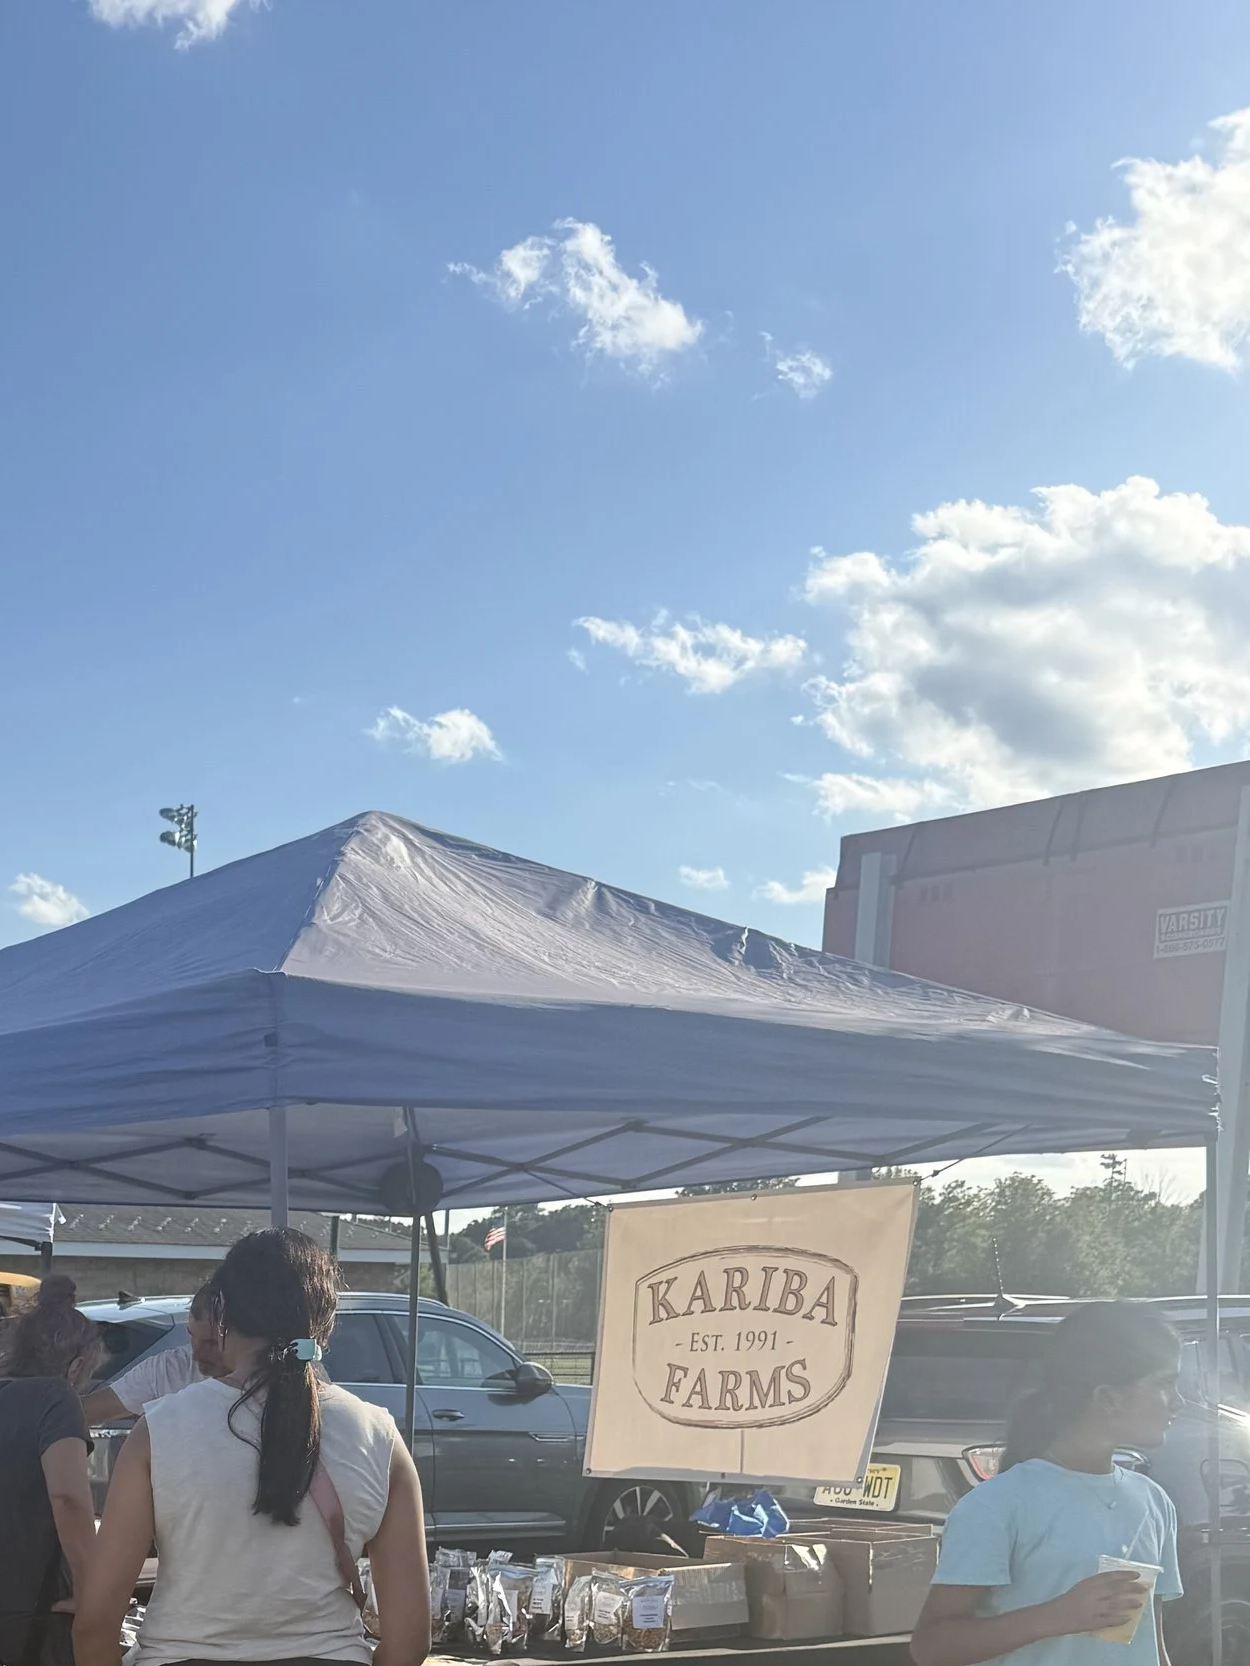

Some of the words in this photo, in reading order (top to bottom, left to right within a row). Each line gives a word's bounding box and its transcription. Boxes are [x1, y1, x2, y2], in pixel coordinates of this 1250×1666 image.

[1159, 907, 1224, 933] VARSITY
[647, 1266, 838, 1327] KARIBA
[689, 1332, 725, 1352] EST.
[734, 1330, 778, 1352] 1991
[659, 1358, 811, 1412] FARMS
[862, 1475, 893, 1499] WDT
[858, 1499, 875, 1507] State
